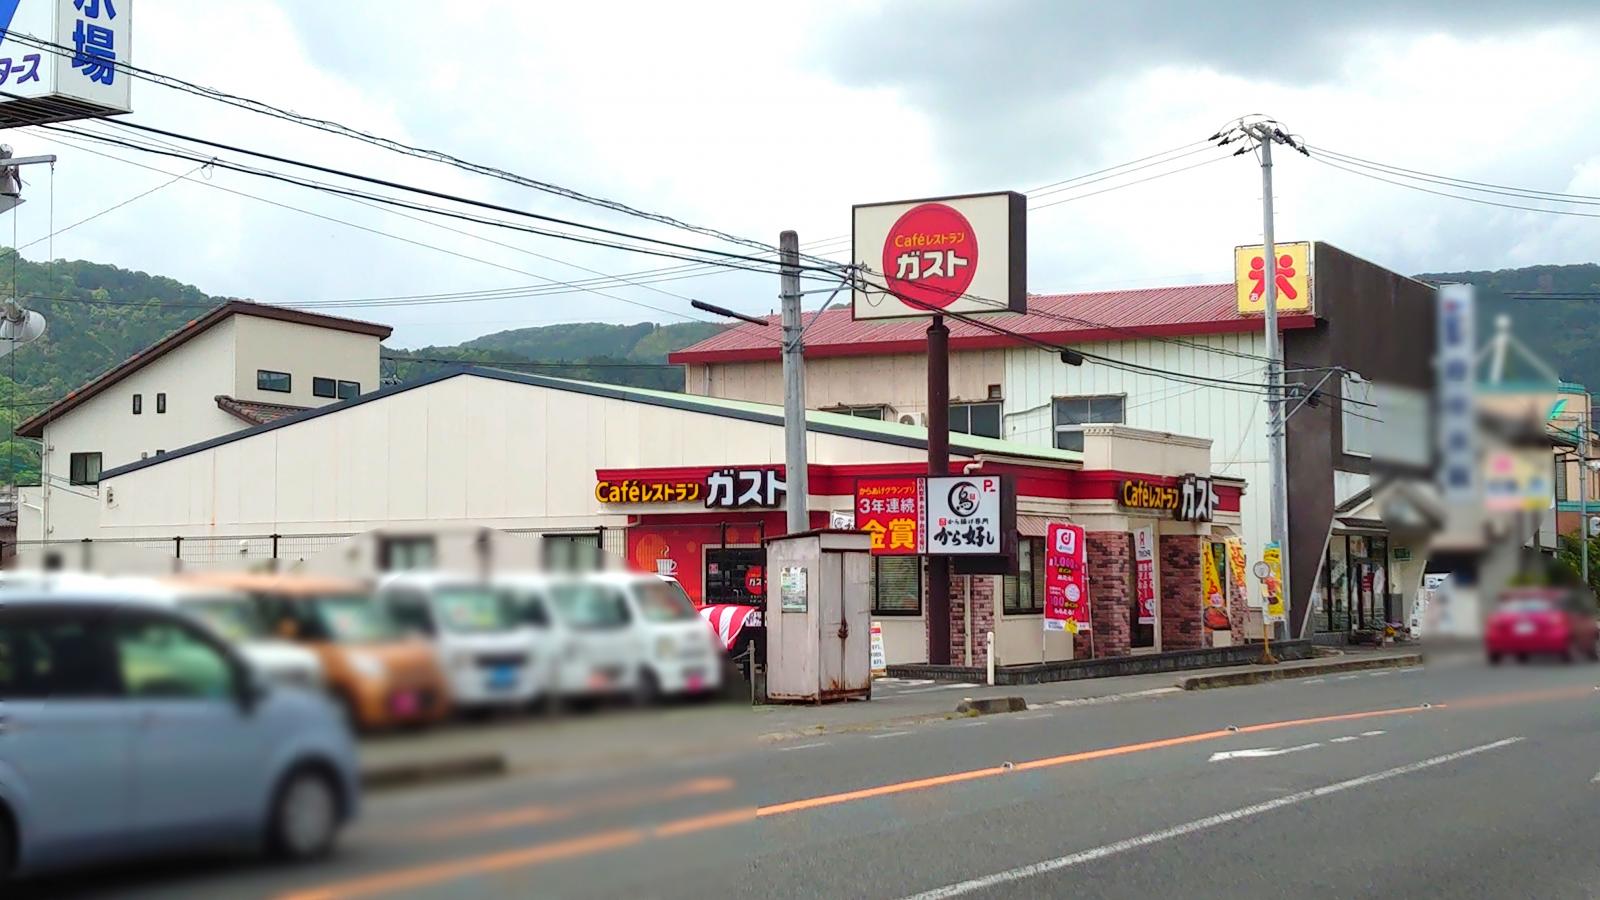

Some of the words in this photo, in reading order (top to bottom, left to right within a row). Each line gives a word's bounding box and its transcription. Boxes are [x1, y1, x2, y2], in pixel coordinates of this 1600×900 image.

[72, 0, 116, 86] 場
[895, 232, 965, 248] Caféレストラン
[896, 249, 968, 280] ガスト
[595, 480, 700, 503] Caféレストラン
[706, 469, 787, 507] ガスト
[859, 487, 915, 495] からあげグランプリ
[983, 479, 993, 492] P
[1123, 480, 1179, 509] Caféレストラン
[1182, 477, 1219, 520] ガスト
[859, 497, 915, 514] 3年連続
[862, 518, 916, 549] 金賞
[933, 525, 995, 548] から好し
